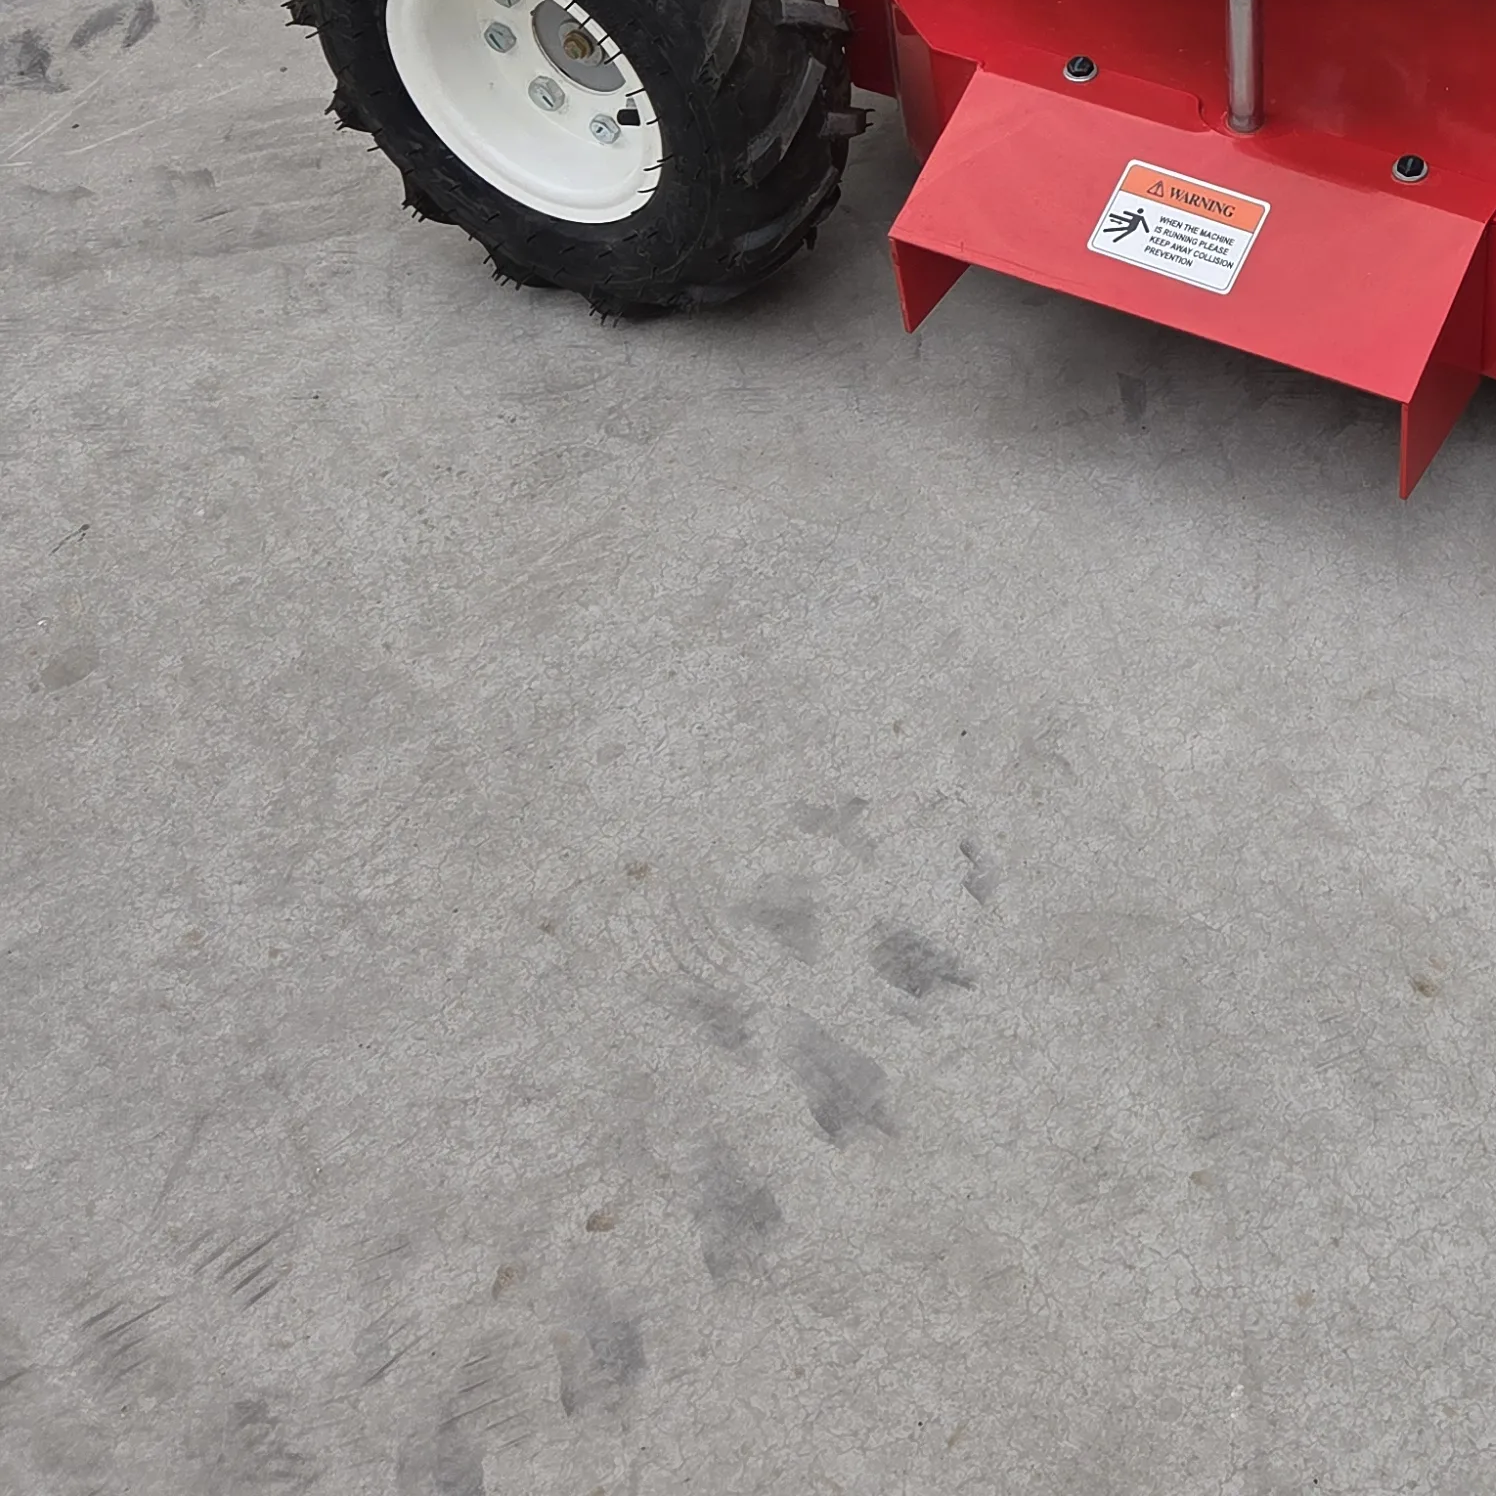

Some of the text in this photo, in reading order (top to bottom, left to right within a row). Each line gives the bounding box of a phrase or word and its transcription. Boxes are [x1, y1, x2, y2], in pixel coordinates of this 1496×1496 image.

[1170, 187, 1236, 217] WARNING
[1154, 225, 1229, 255] IS RUNNING PLEASE
[1159, 216, 1235, 246] WHEN THE MACHINE
[1144, 245, 1193, 267] PREVENTION
[1149, 235, 1234, 269] KEEP AWAY COLLISION
